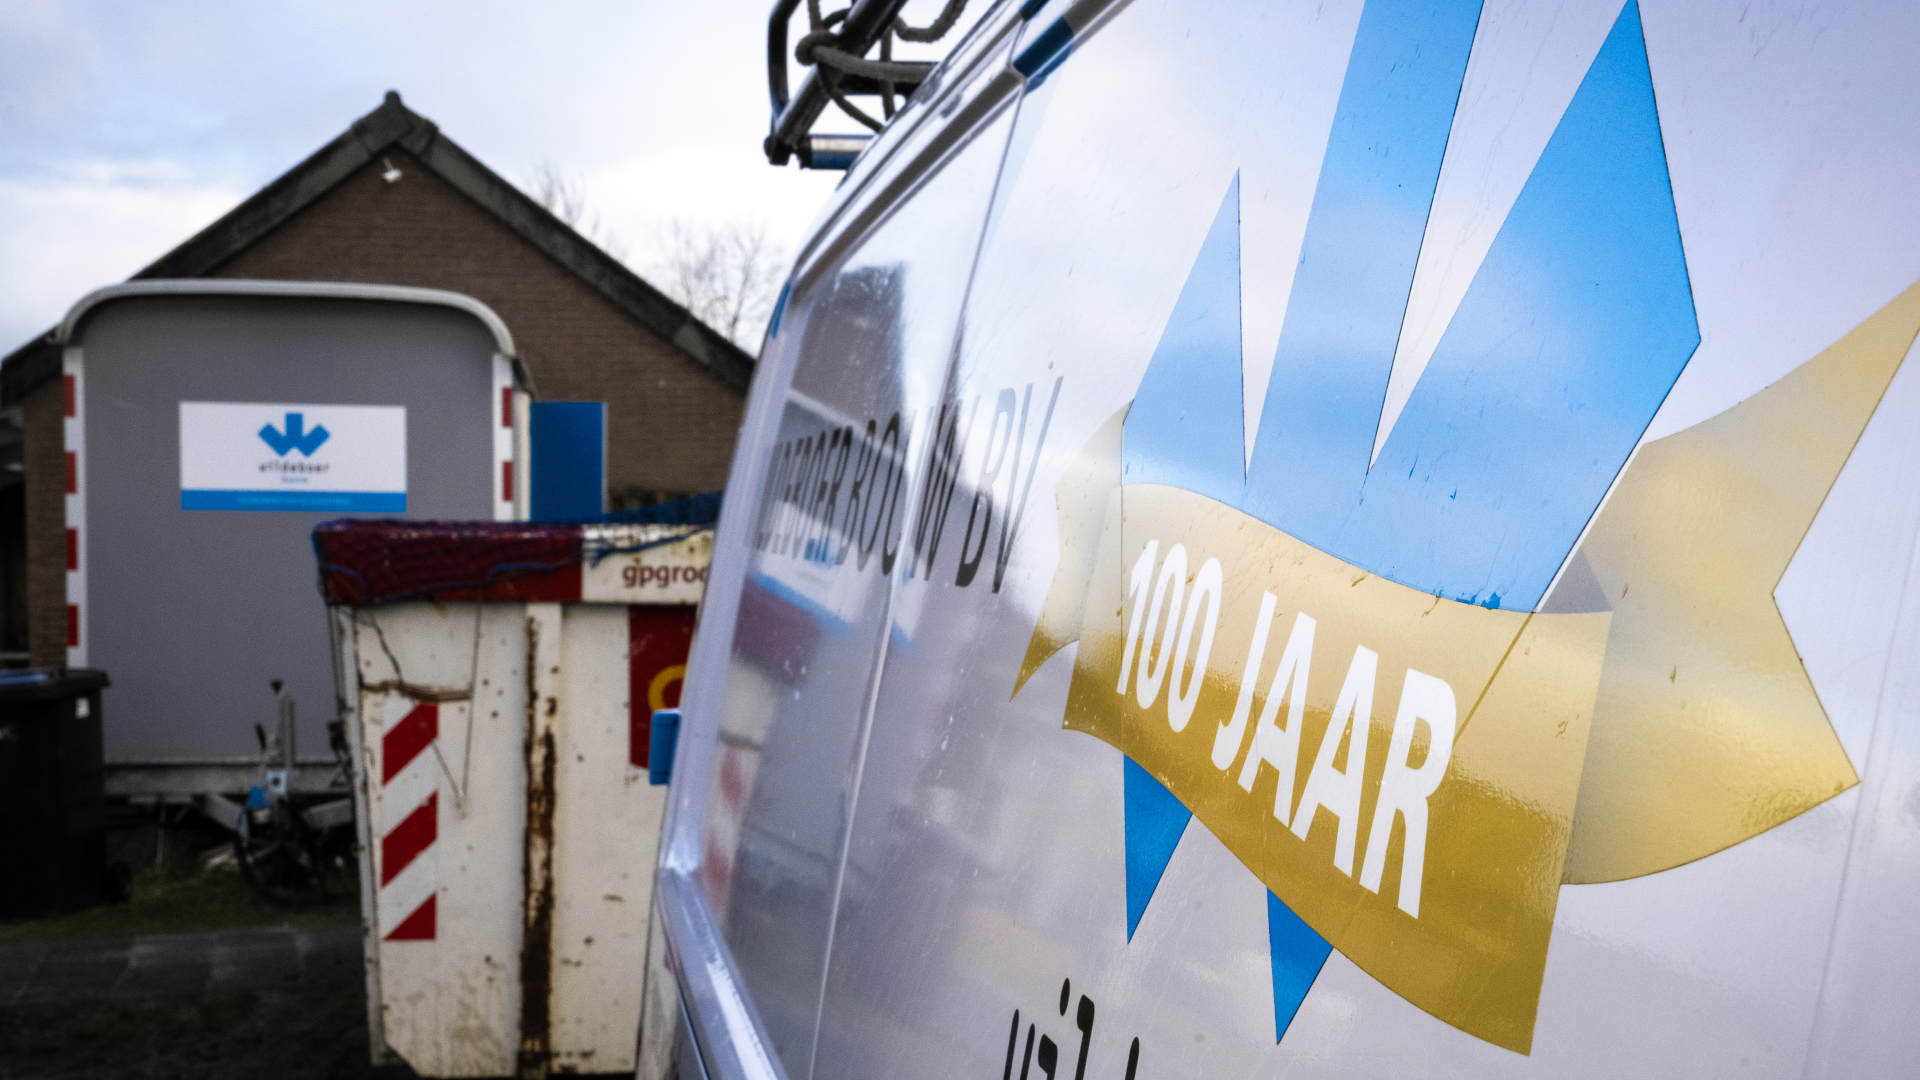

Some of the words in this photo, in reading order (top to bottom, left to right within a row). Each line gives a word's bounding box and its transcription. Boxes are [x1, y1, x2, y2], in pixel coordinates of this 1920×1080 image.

[753, 425, 853, 563] DEBOER
[836, 395, 980, 581] BOUW
[955, 376, 1064, 593] BV
[1116, 539, 1223, 733] 100
[1210, 590, 1457, 920] JAAR
